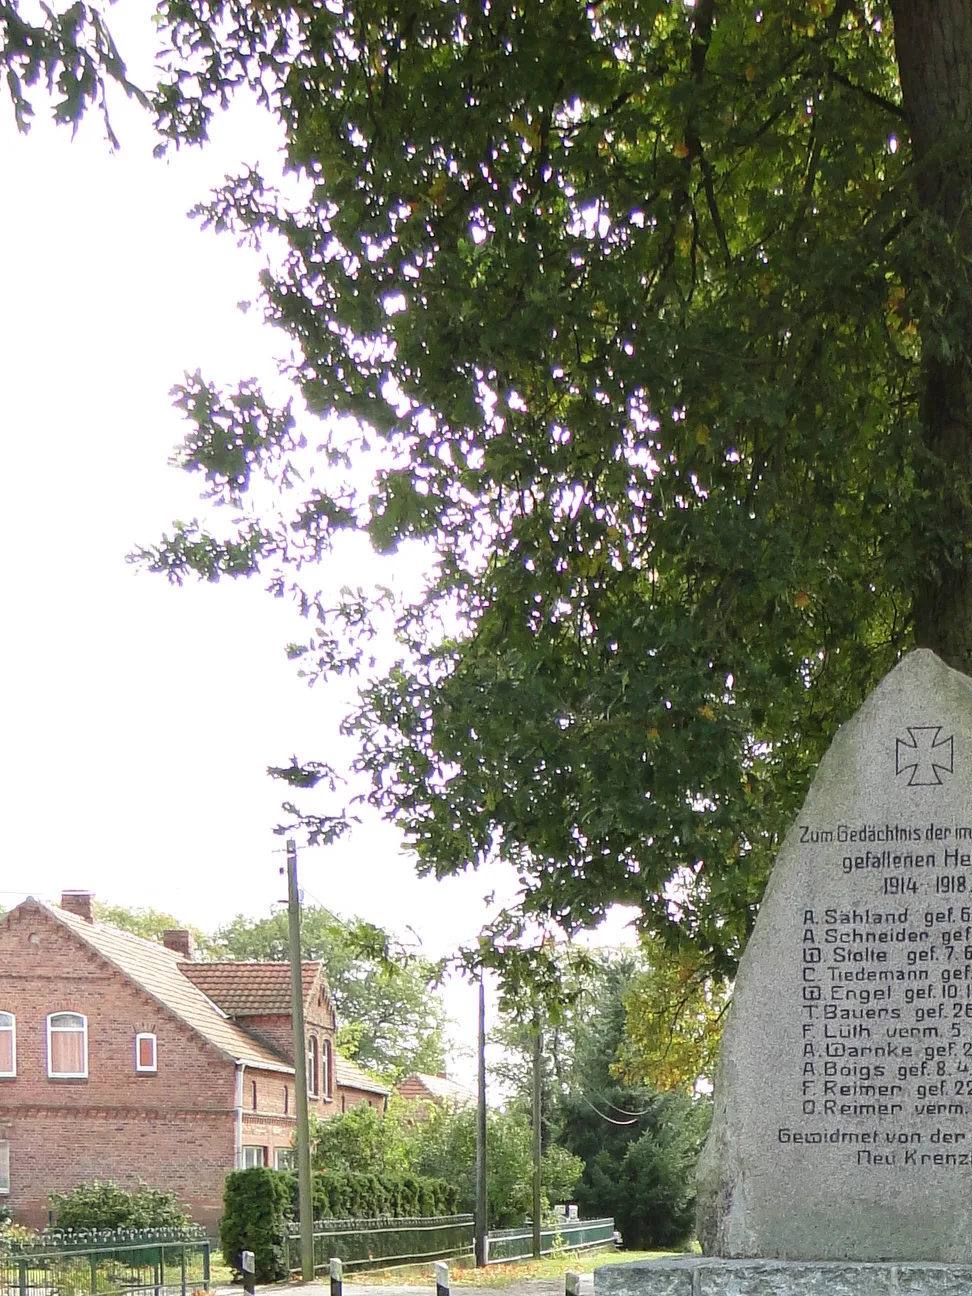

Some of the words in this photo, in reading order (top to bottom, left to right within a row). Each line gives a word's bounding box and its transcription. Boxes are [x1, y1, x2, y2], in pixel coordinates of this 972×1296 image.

[800, 826, 833, 843] Zum
[837, 823, 922, 842] Gedächtnis
[925, 823, 951, 840] der
[955, 824, 972, 839] im
[842, 850, 936, 873] gefallenen
[883, 876, 919, 895] 1914
[825, 928, 929, 943] Schneider
[833, 947, 887, 962] Stolte
[831, 985, 892, 1005] Engel
[825, 1023, 871, 1039] Lüth
[824, 1080, 902, 1096] Reimer
[824, 1100, 903, 1115] Reimer
[778, 1127, 878, 1144] Gewidmet
[886, 1132, 921, 1143] von
[930, 1128, 965, 1143] der
